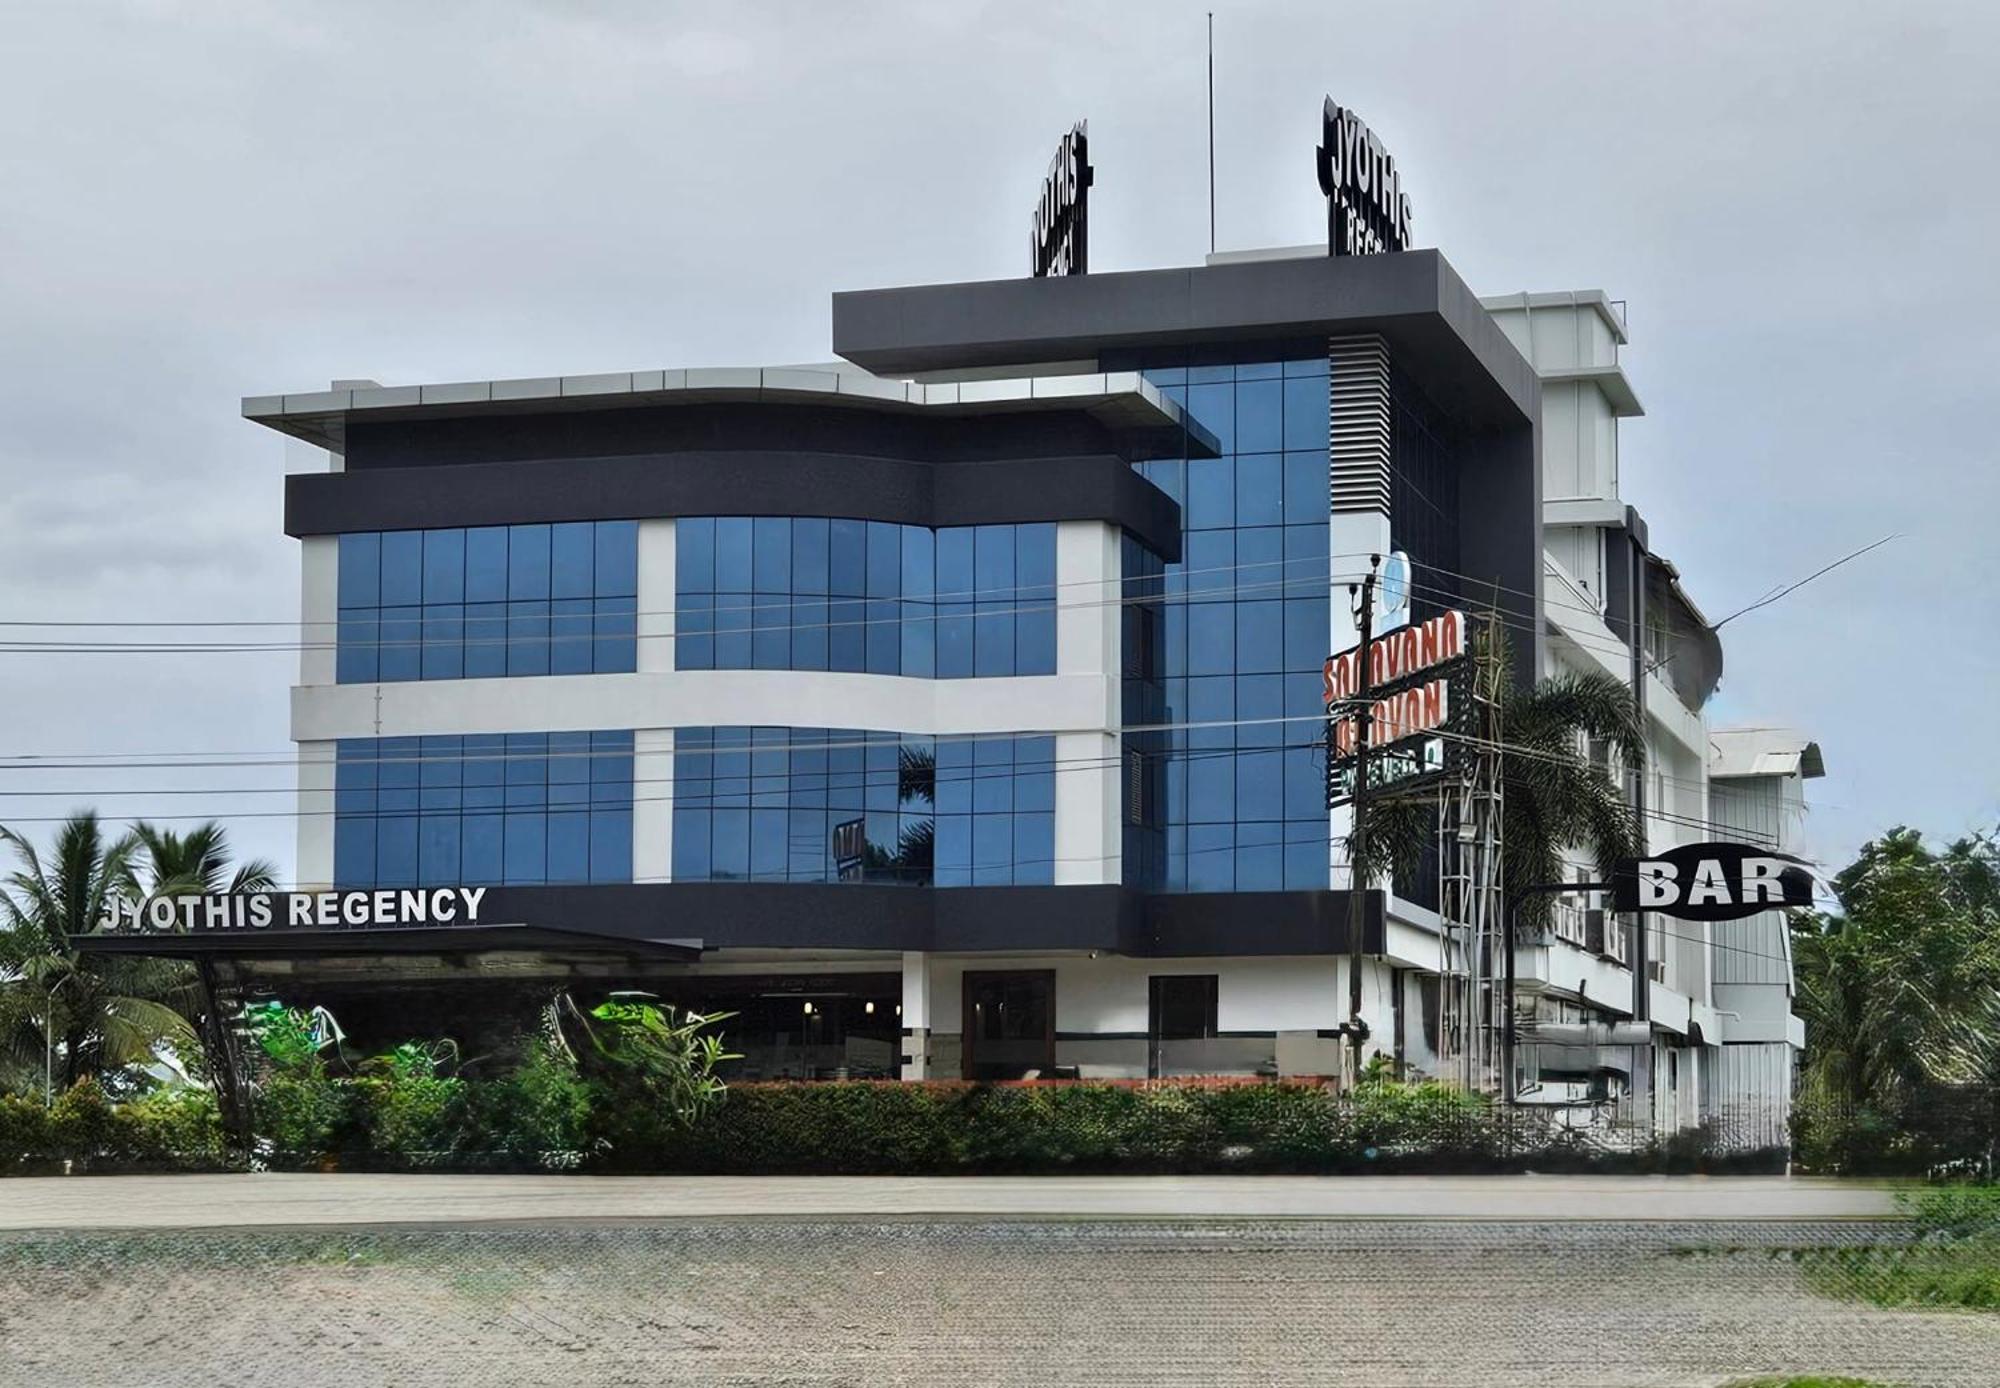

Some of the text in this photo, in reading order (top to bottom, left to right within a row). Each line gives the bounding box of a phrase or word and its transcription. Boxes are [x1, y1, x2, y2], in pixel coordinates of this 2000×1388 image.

[1331, 106, 1414, 258] JYOTHIS
[1638, 857, 1786, 906] BAR
[102, 888, 487, 930] JYOTHIS REGENCY
